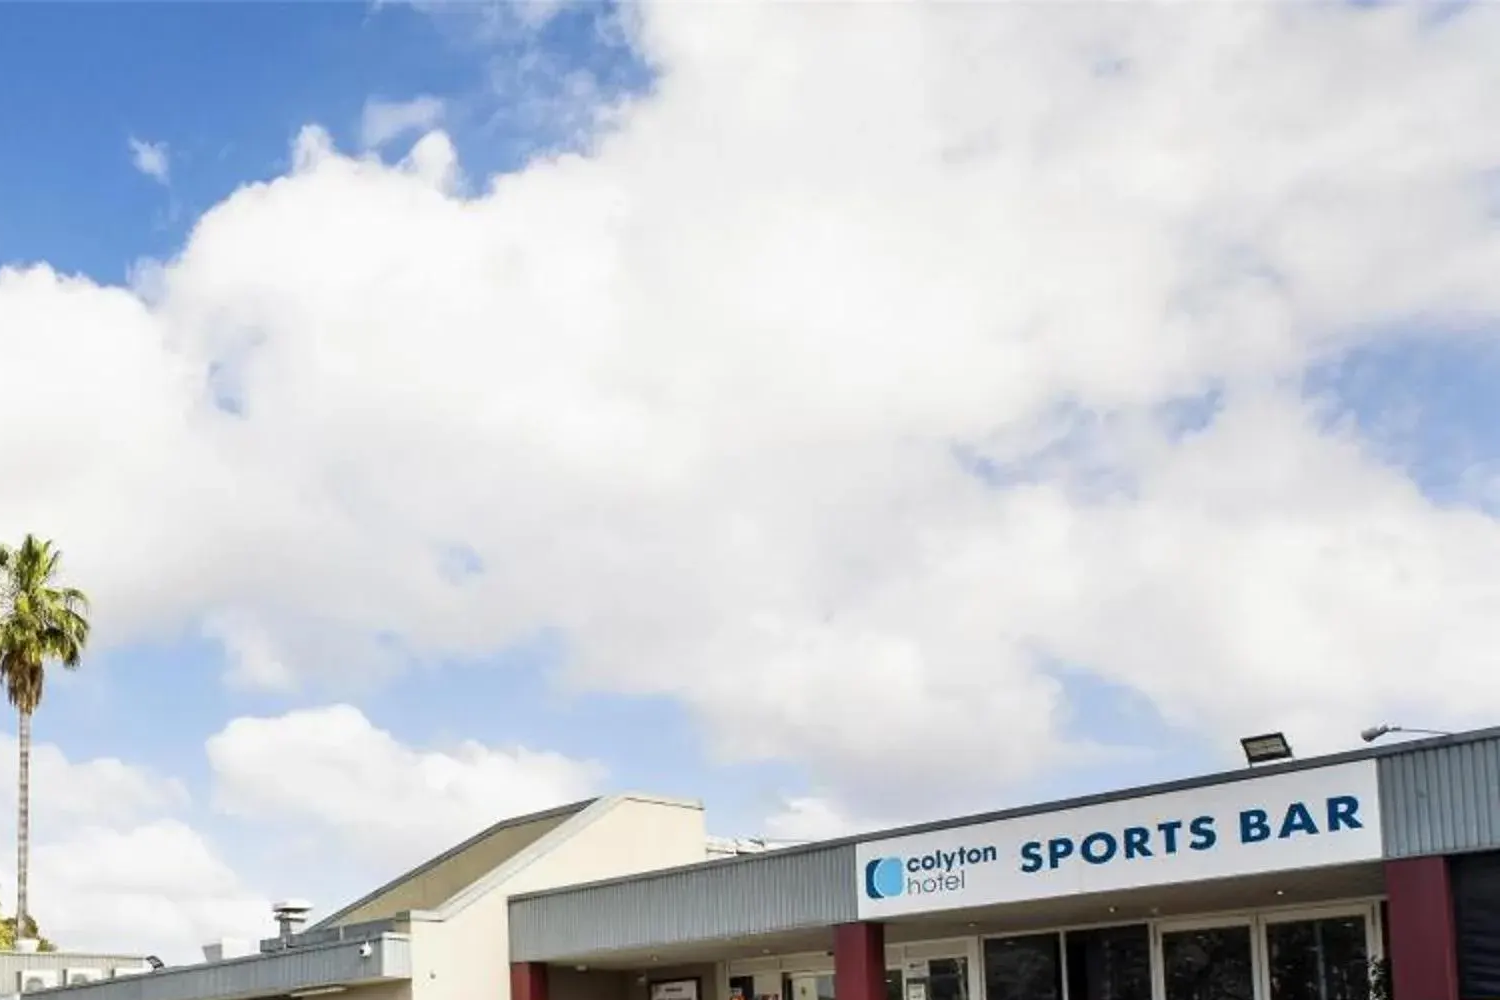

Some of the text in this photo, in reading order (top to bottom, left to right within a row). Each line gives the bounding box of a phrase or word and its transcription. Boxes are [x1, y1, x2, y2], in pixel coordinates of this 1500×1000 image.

[1020, 794, 1365, 874] SPORTS BAR
[906, 845, 998, 873] colyton
[906, 869, 966, 895] hotel
